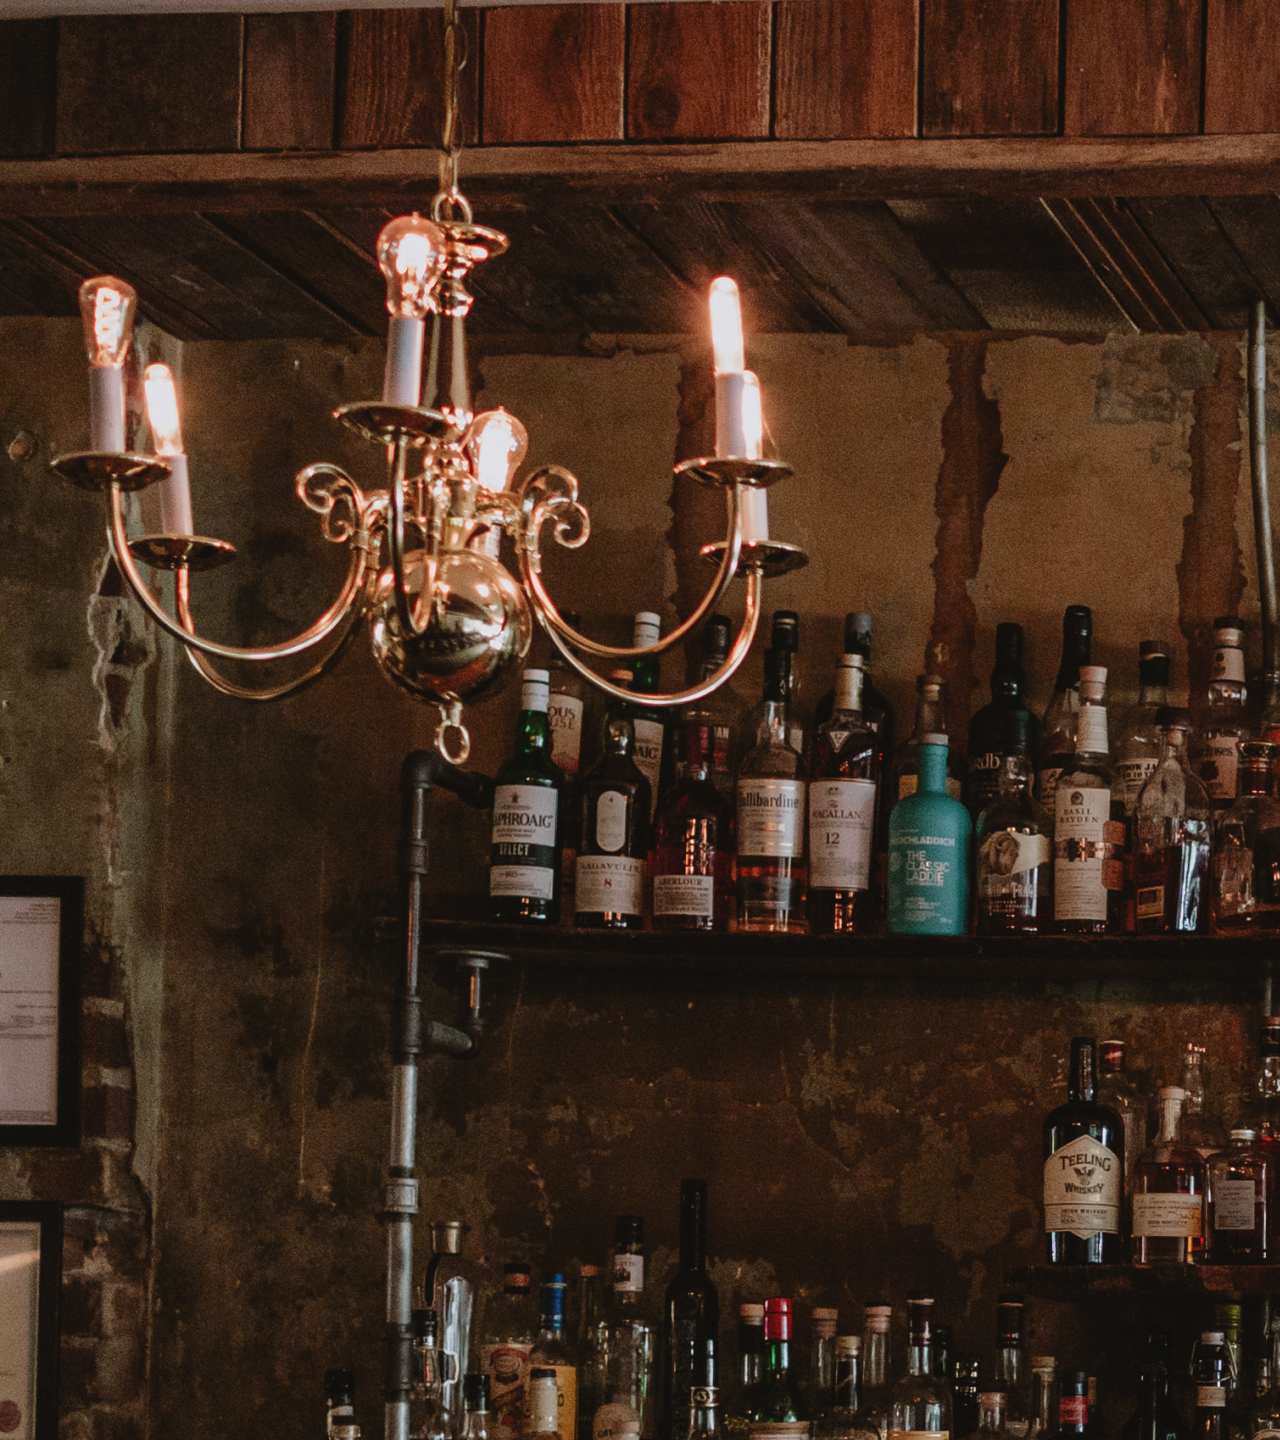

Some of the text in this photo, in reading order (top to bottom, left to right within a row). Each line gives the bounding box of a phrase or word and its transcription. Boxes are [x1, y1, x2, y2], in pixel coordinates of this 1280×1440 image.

[824, 832, 840, 845] 12
[907, 850, 926, 860] THE
[906, 862, 951, 872] CLASSIC
[906, 872, 945, 882] LADDIE
[1059, 1153, 1112, 1172] TEELING
[1064, 1182, 1104, 1194] WHISKEY
